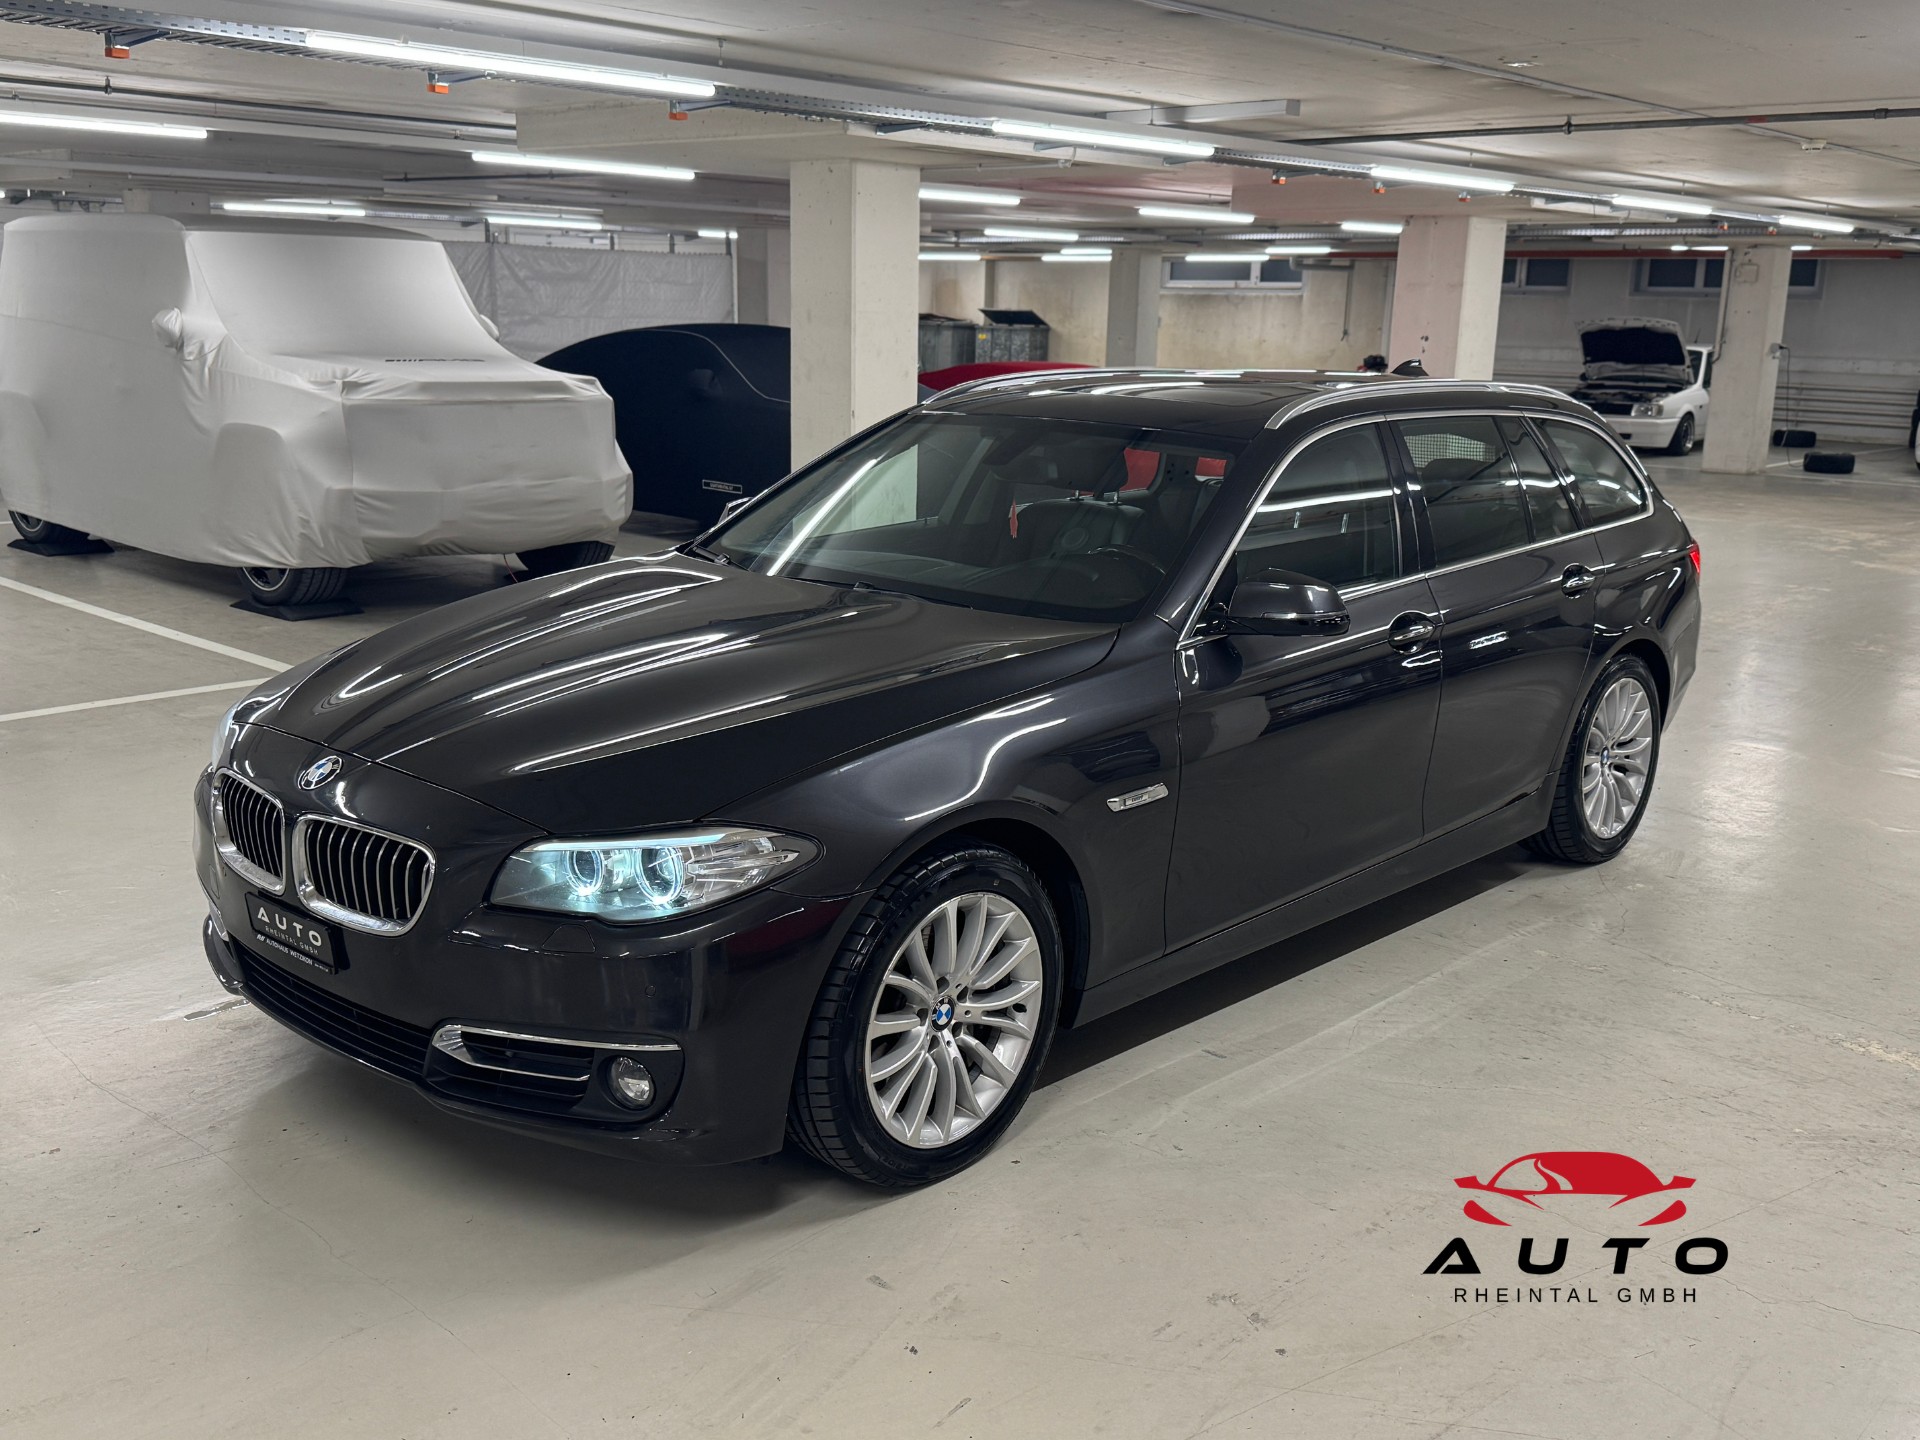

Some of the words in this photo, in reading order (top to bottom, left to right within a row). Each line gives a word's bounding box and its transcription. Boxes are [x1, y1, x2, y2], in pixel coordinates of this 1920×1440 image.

[257, 906, 322, 947] AUTO
[265, 925, 298, 946] RHEINTAL
[266, 937, 289, 954] AUTOHAUS
